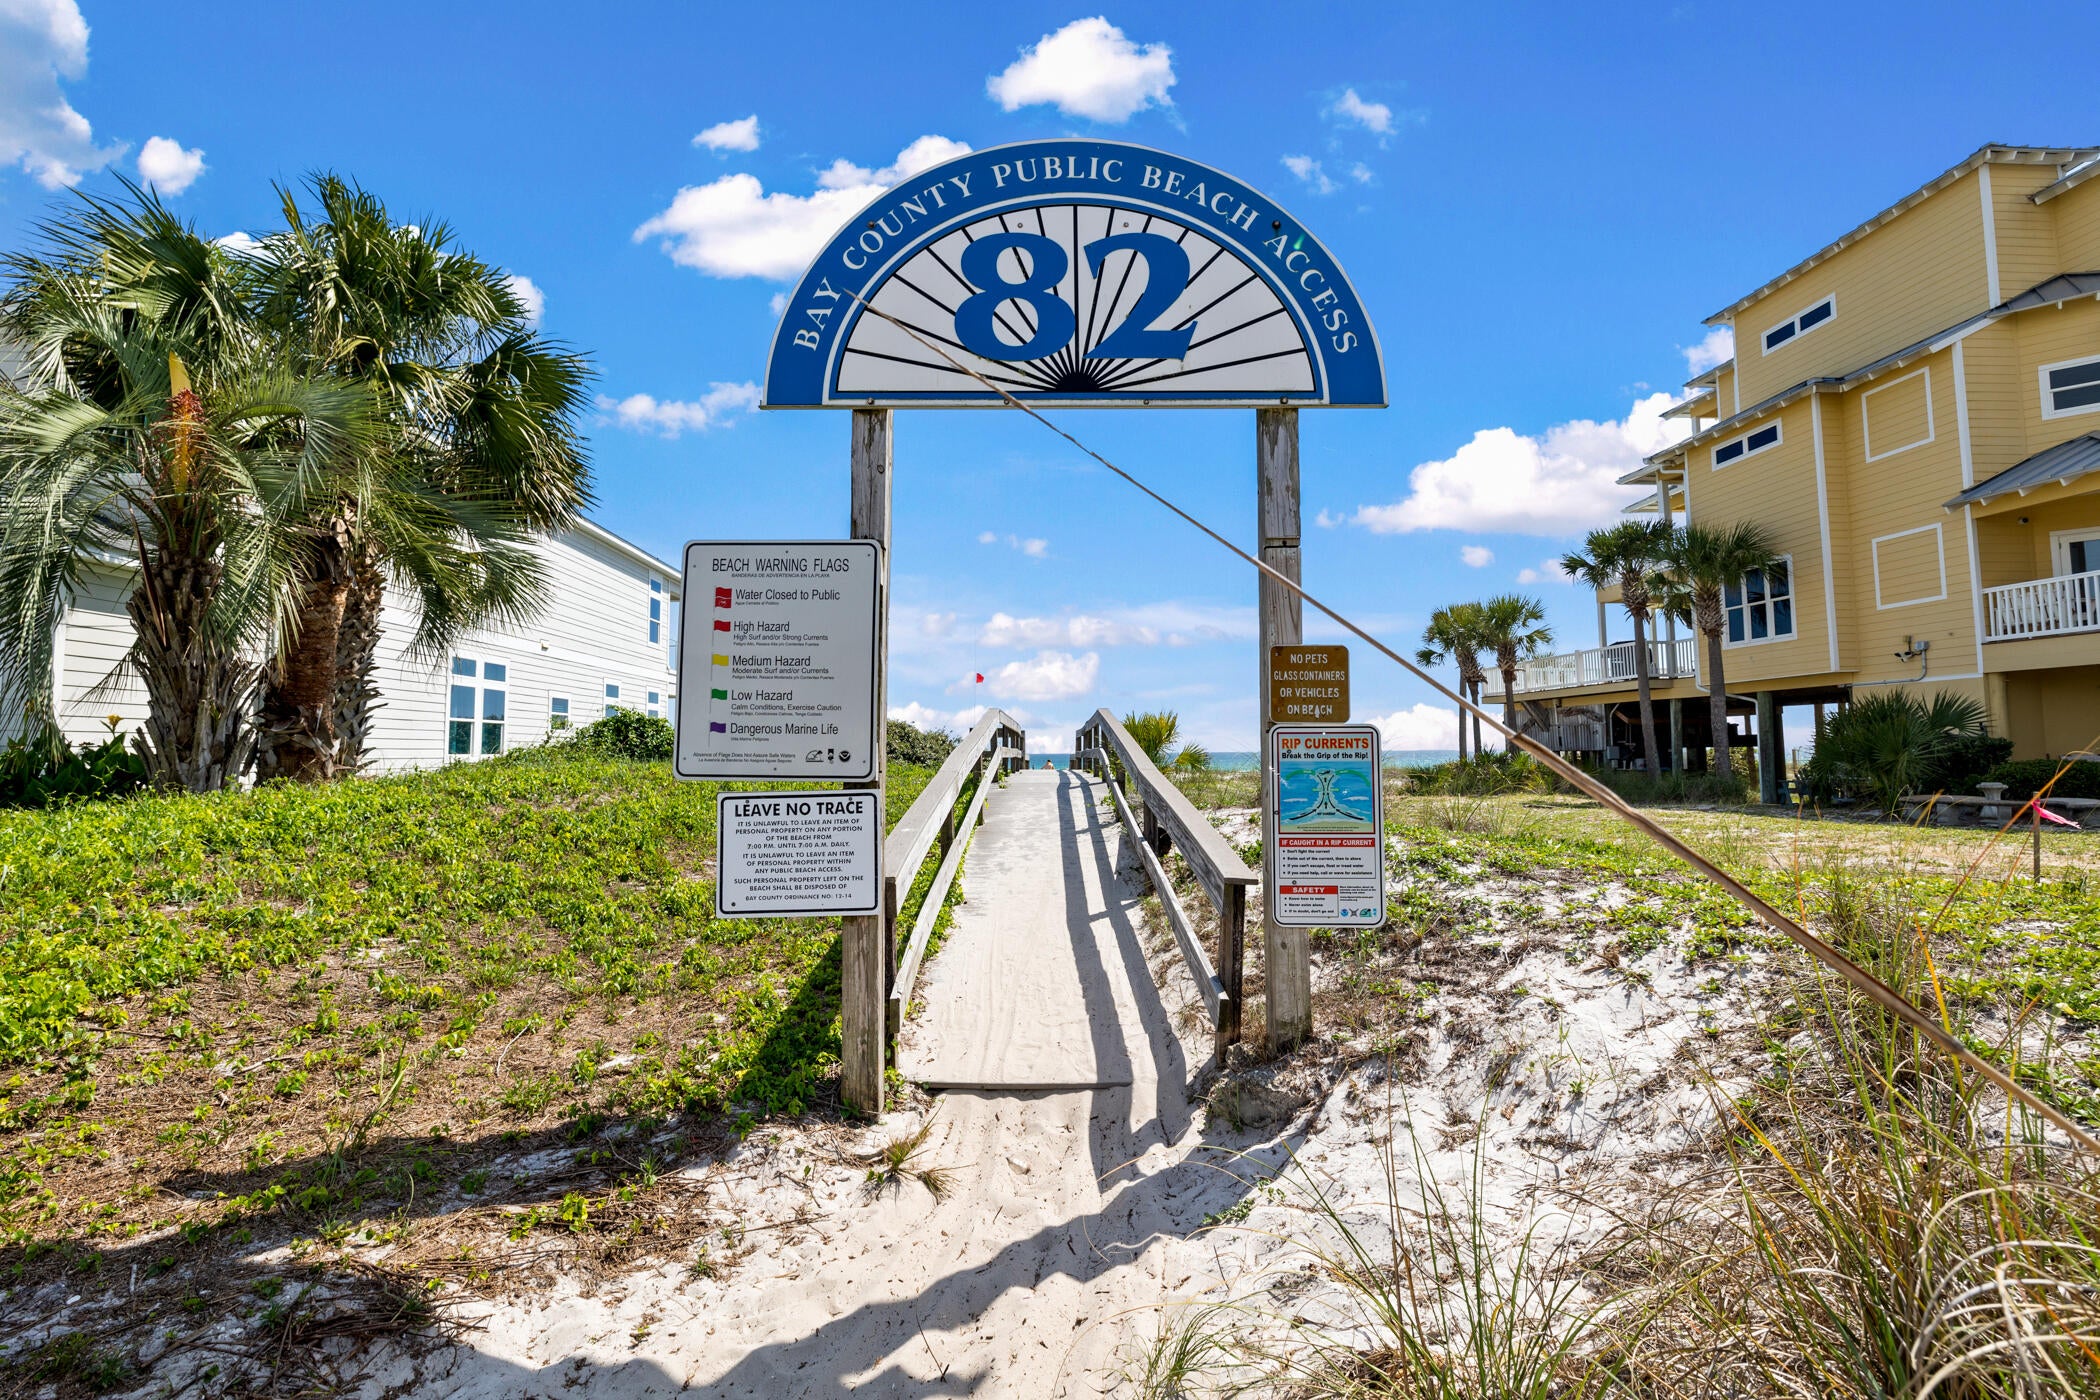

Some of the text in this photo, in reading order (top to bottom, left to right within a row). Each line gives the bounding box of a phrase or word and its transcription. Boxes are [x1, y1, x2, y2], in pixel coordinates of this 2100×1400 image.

[793, 156, 1358, 354] BAY COUNTY PUBLIC BEACH ACCESS
[954, 232, 1198, 362] 82
[712, 559, 849, 572] BEACH WARNING FLAGS
[735, 589, 840, 600] Water Closed to Public
[734, 621, 790, 634] High Hazard
[732, 656, 811, 666] Medium Hazard
[1290, 654, 1328, 664] NO PETS
[1274, 671, 1345, 680] GLASS CONTAINERS
[731, 690, 793, 700] Low Hazard
[1280, 688, 1339, 698] OR VEHICLES
[1287, 705, 1332, 715] ON BEACH
[730, 723, 839, 736] Dangerous Marine Life
[1282, 738, 1369, 749] RIP CURRENTS
[734, 801, 863, 817] LEAVE NO TRACE
